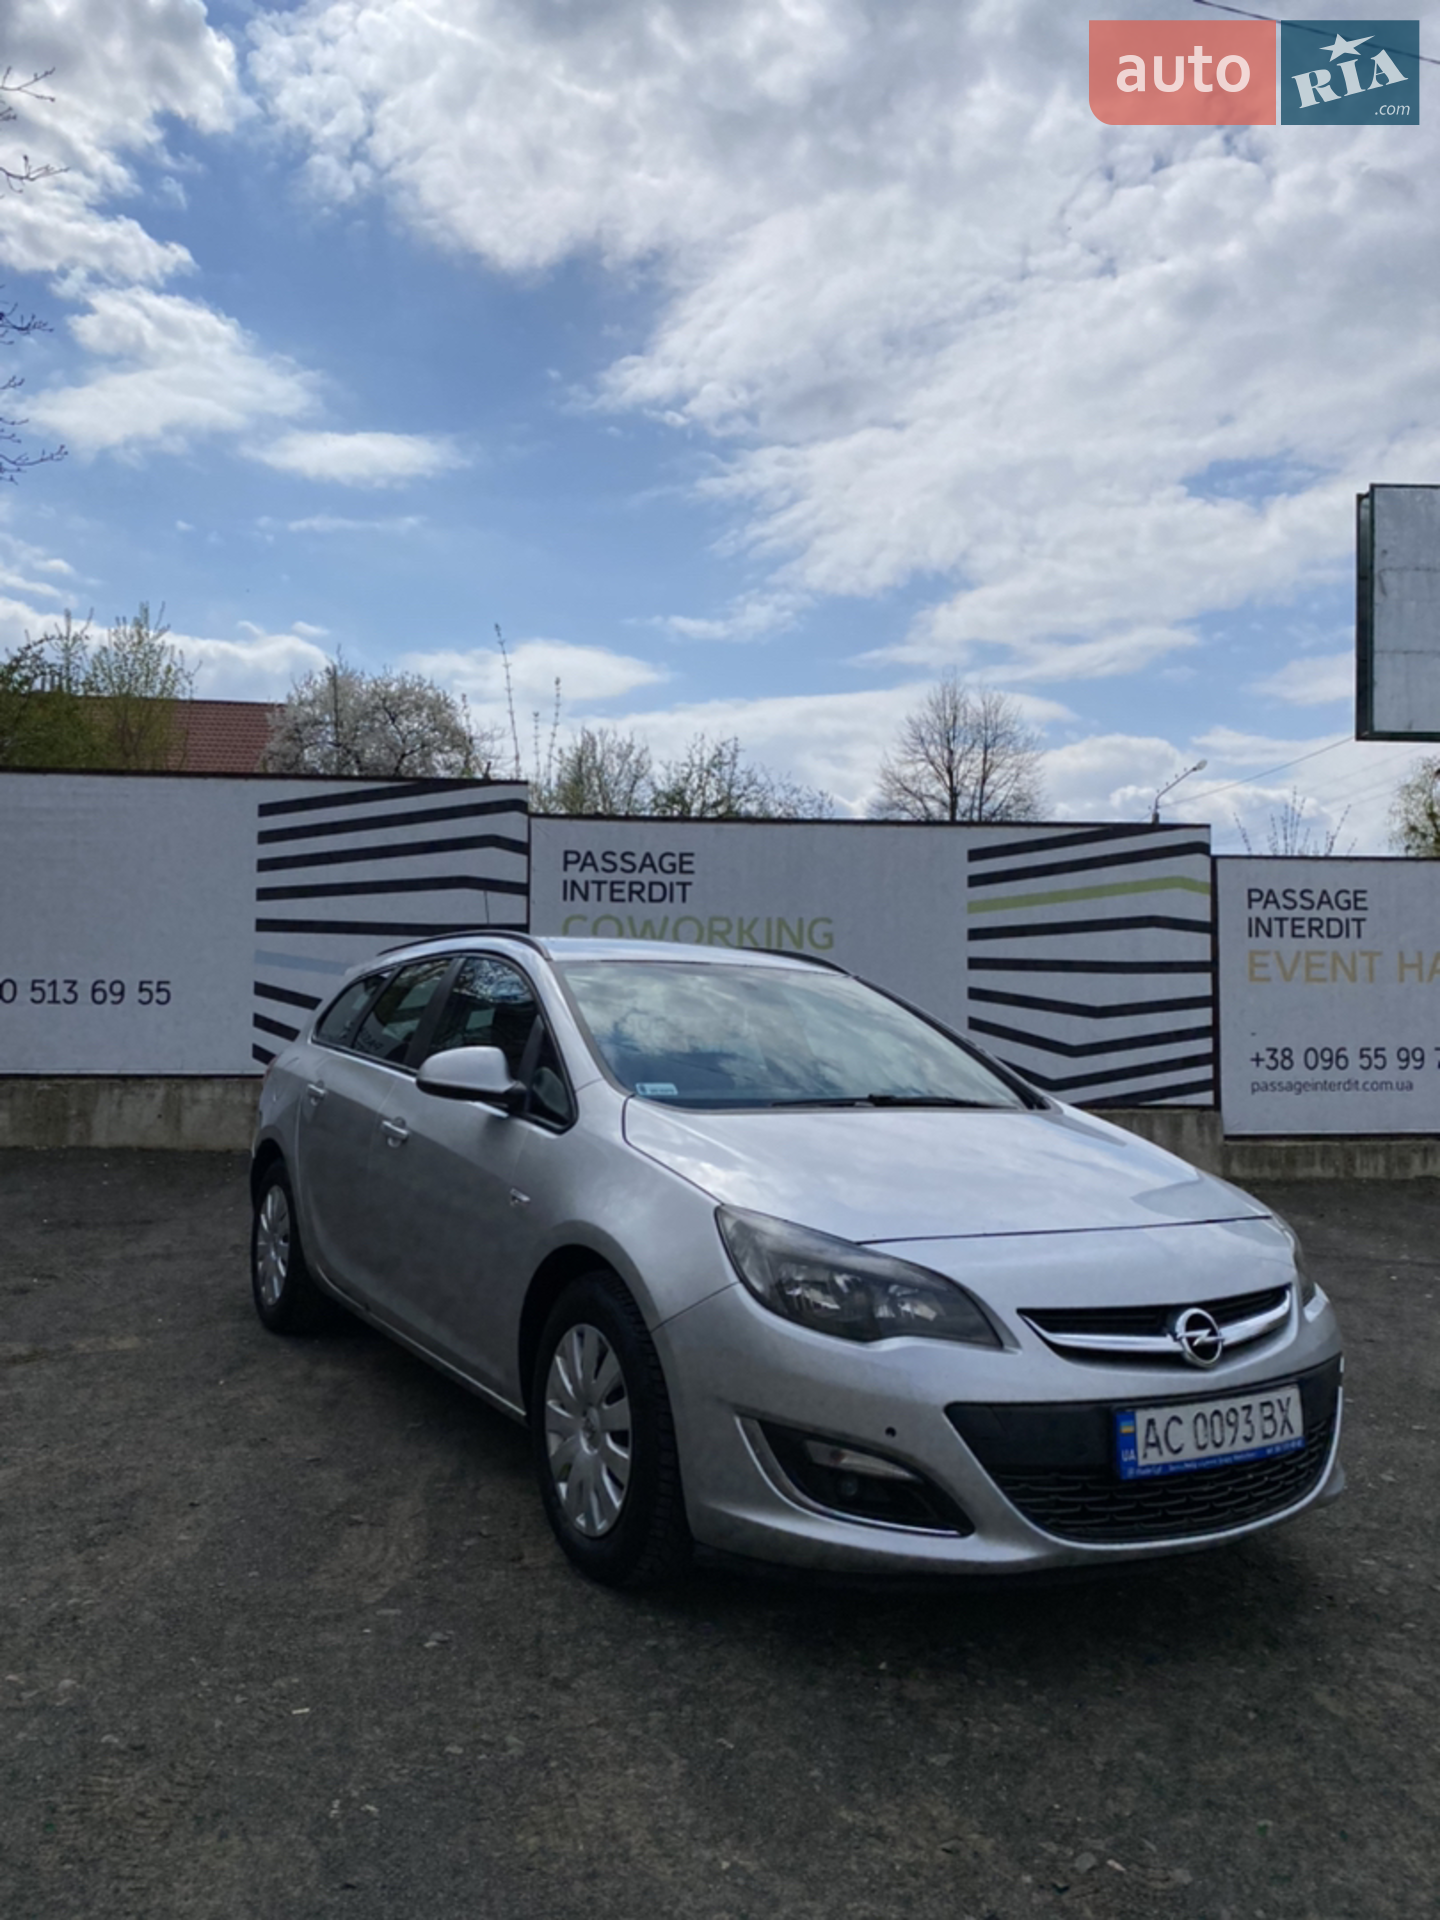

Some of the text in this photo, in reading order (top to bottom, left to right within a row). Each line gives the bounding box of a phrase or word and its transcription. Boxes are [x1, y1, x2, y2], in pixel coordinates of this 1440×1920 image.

[562, 850, 695, 874] PASSAGE
[562, 880, 693, 903] INTERDIT
[1247, 888, 1368, 911] PASSAGE
[562, 914, 834, 950] COWORKING
[1248, 917, 1366, 939] INTERDIT
[1248, 950, 1383, 983] EVENT
[0, 978, 171, 1006] 0 513 69 55
[1250, 1047, 1294, 1071] +38
[1303, 1046, 1349, 1071] 096
[1359, 1047, 1387, 1071] 55
[1396, 1046, 1425, 1071] 99
[1251, 1079, 1414, 1095] passageinterdit.com.ua
